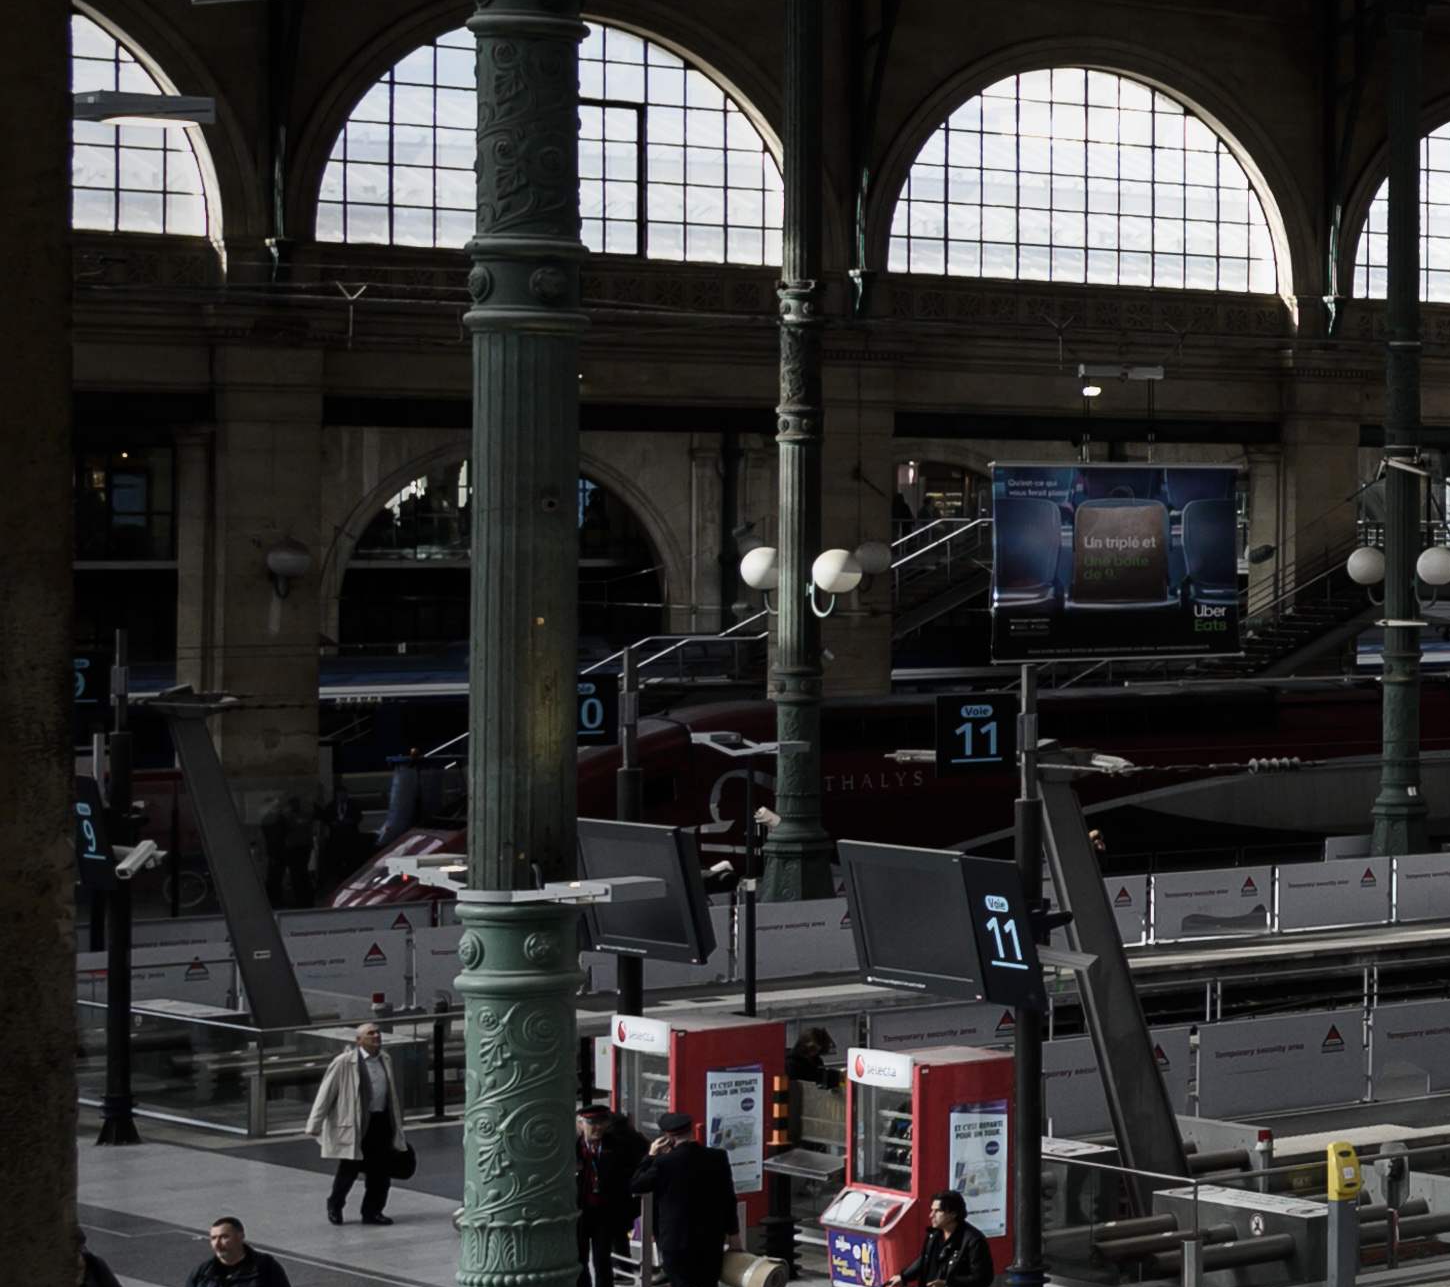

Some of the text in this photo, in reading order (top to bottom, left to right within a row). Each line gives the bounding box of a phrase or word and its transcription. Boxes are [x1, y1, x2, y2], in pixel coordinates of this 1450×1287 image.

[1084, 536, 1156, 550] Un triplé et
[1193, 605, 1227, 618] Uber
[1193, 618, 1227, 633] Eats
[965, 705, 990, 717] Voie
[953, 721, 999, 757] 11
[824, 770, 926, 793] THALYS
[988, 898, 1005, 910] Voie
[985, 916, 1023, 960] 11
[883, 1027, 977, 1043] Temporary security area
[1215, 1043, 1304, 1060] Temporary security area
